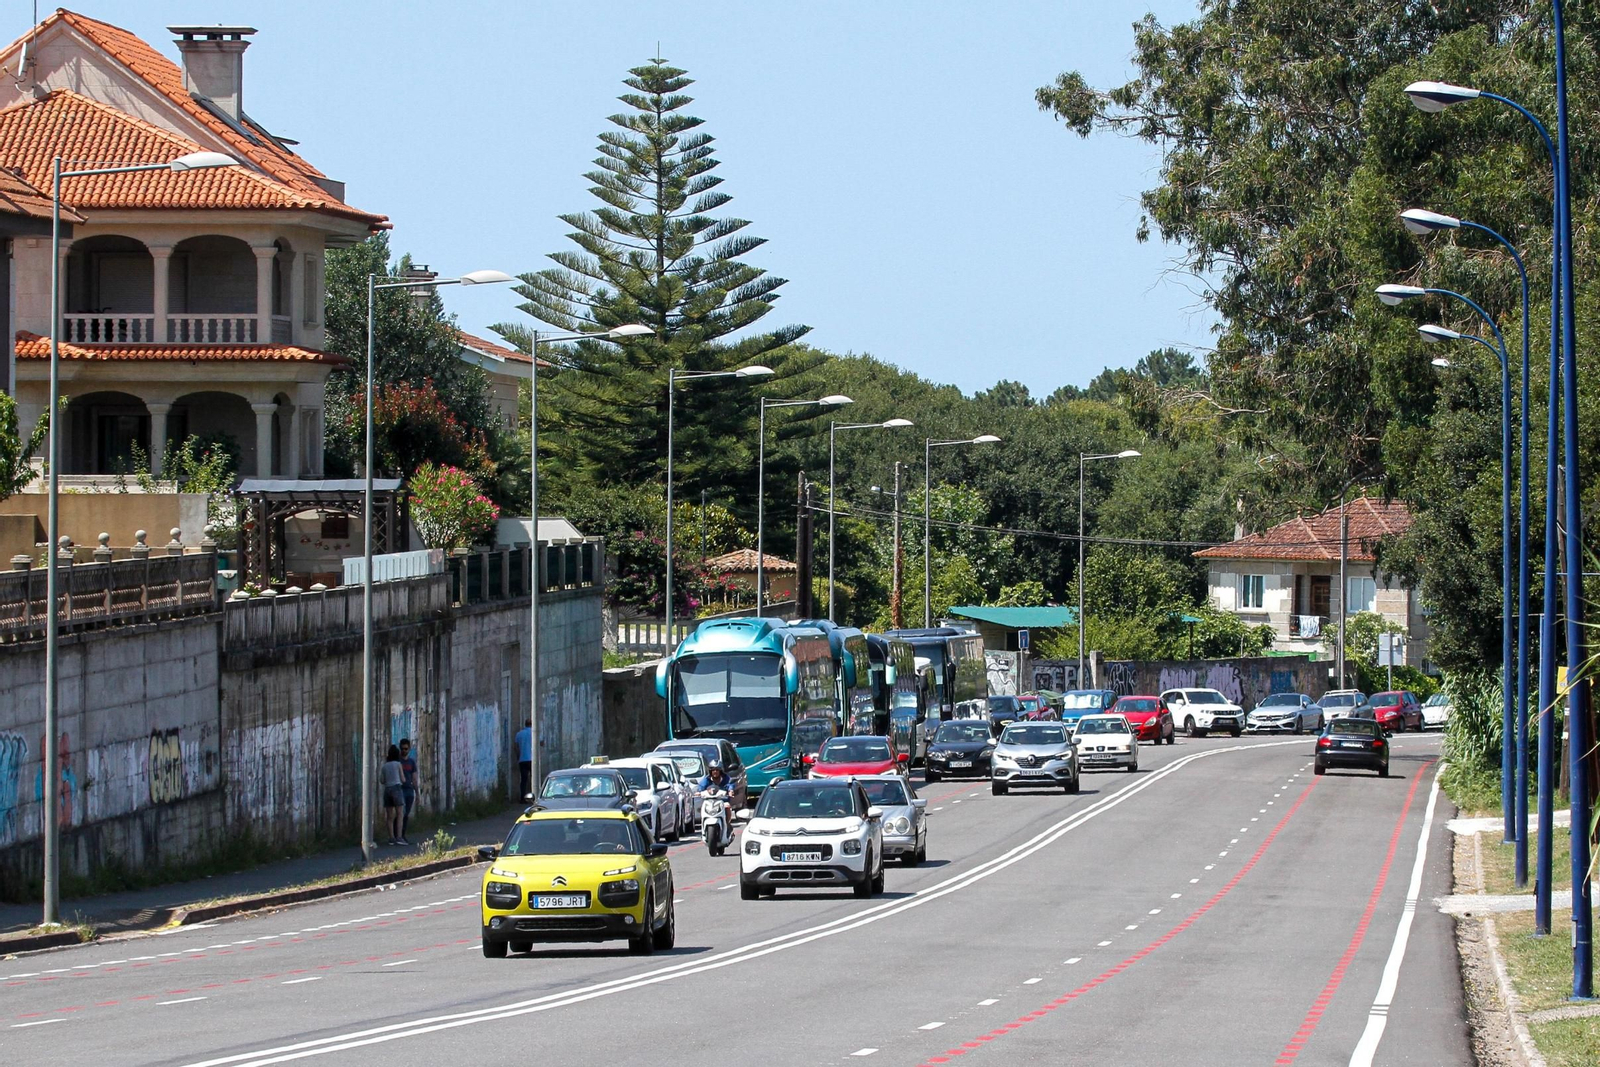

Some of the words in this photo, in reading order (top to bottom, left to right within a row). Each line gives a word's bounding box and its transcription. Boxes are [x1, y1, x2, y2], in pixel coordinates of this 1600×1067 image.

[787, 853, 804, 861] 8716
[540, 897, 563, 907] 5796
[567, 896, 584, 906] JRT
